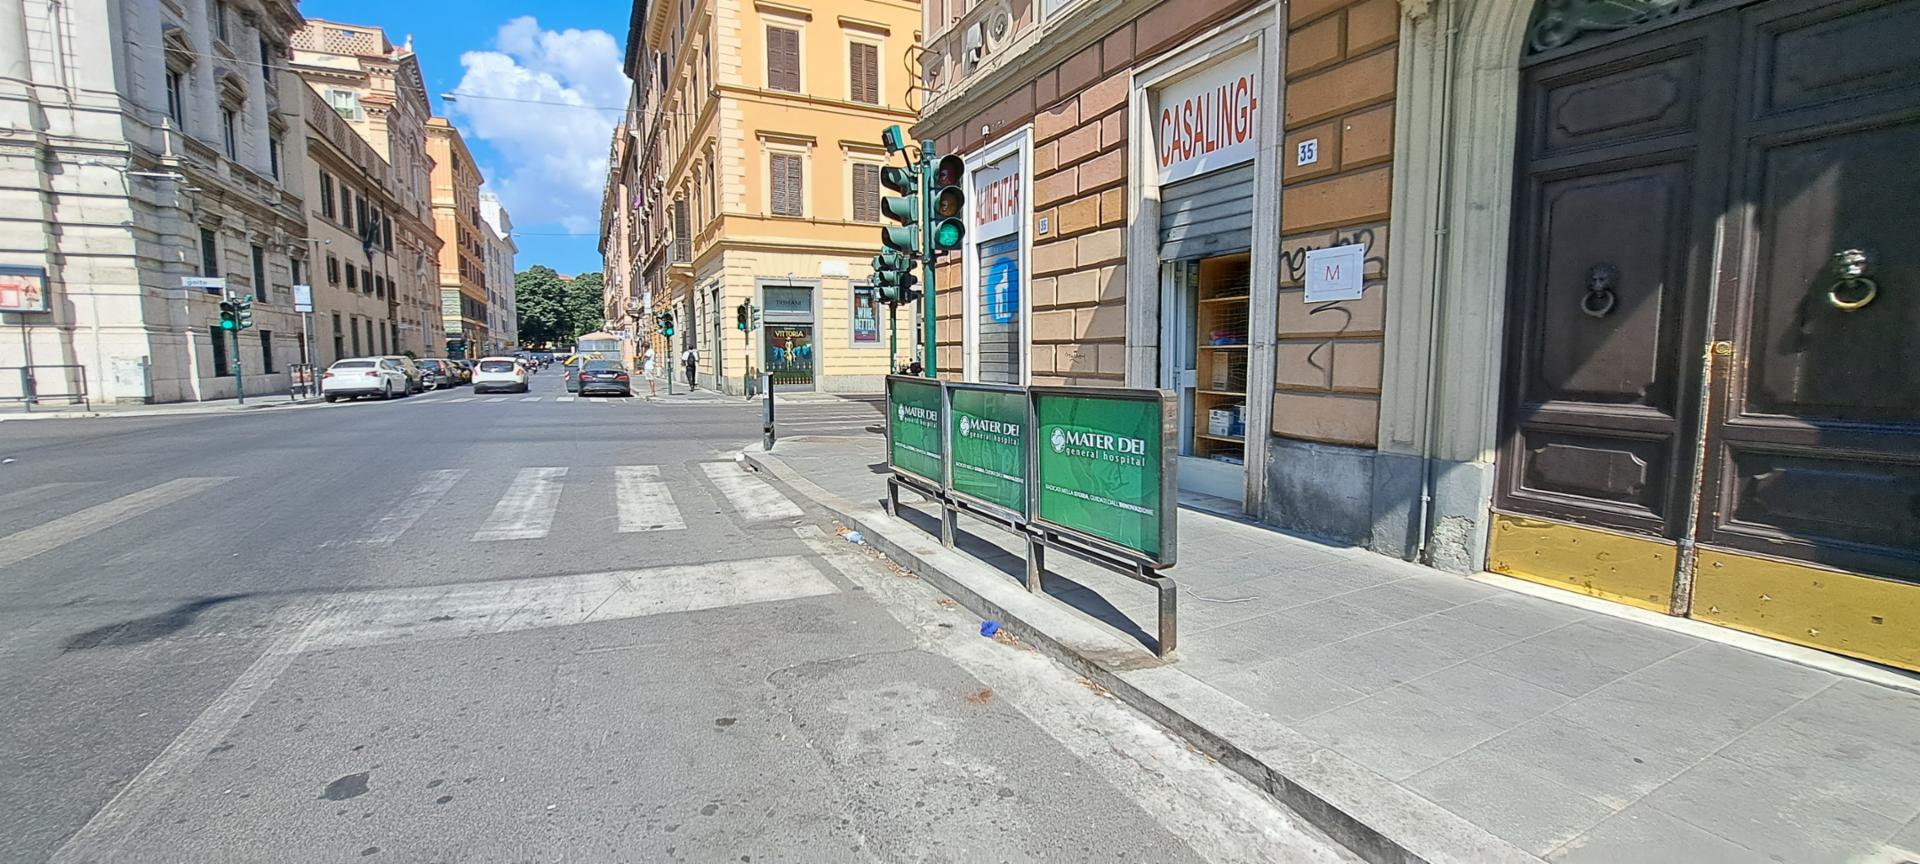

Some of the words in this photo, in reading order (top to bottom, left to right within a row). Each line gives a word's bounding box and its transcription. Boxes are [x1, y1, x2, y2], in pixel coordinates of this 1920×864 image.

[1300, 142, 1314, 162] 35
[1325, 264, 1340, 280] M
[904, 405, 926, 419] MATER
[926, 409, 937, 421] DEI
[970, 418, 1001, 433] MATER
[1003, 423, 1020, 437] DEI
[1066, 430, 1114, 451] MATER
[1118, 437, 1145, 455] DEI
[1065, 447, 1099, 458] general
[1103, 452, 1145, 467] hospital
